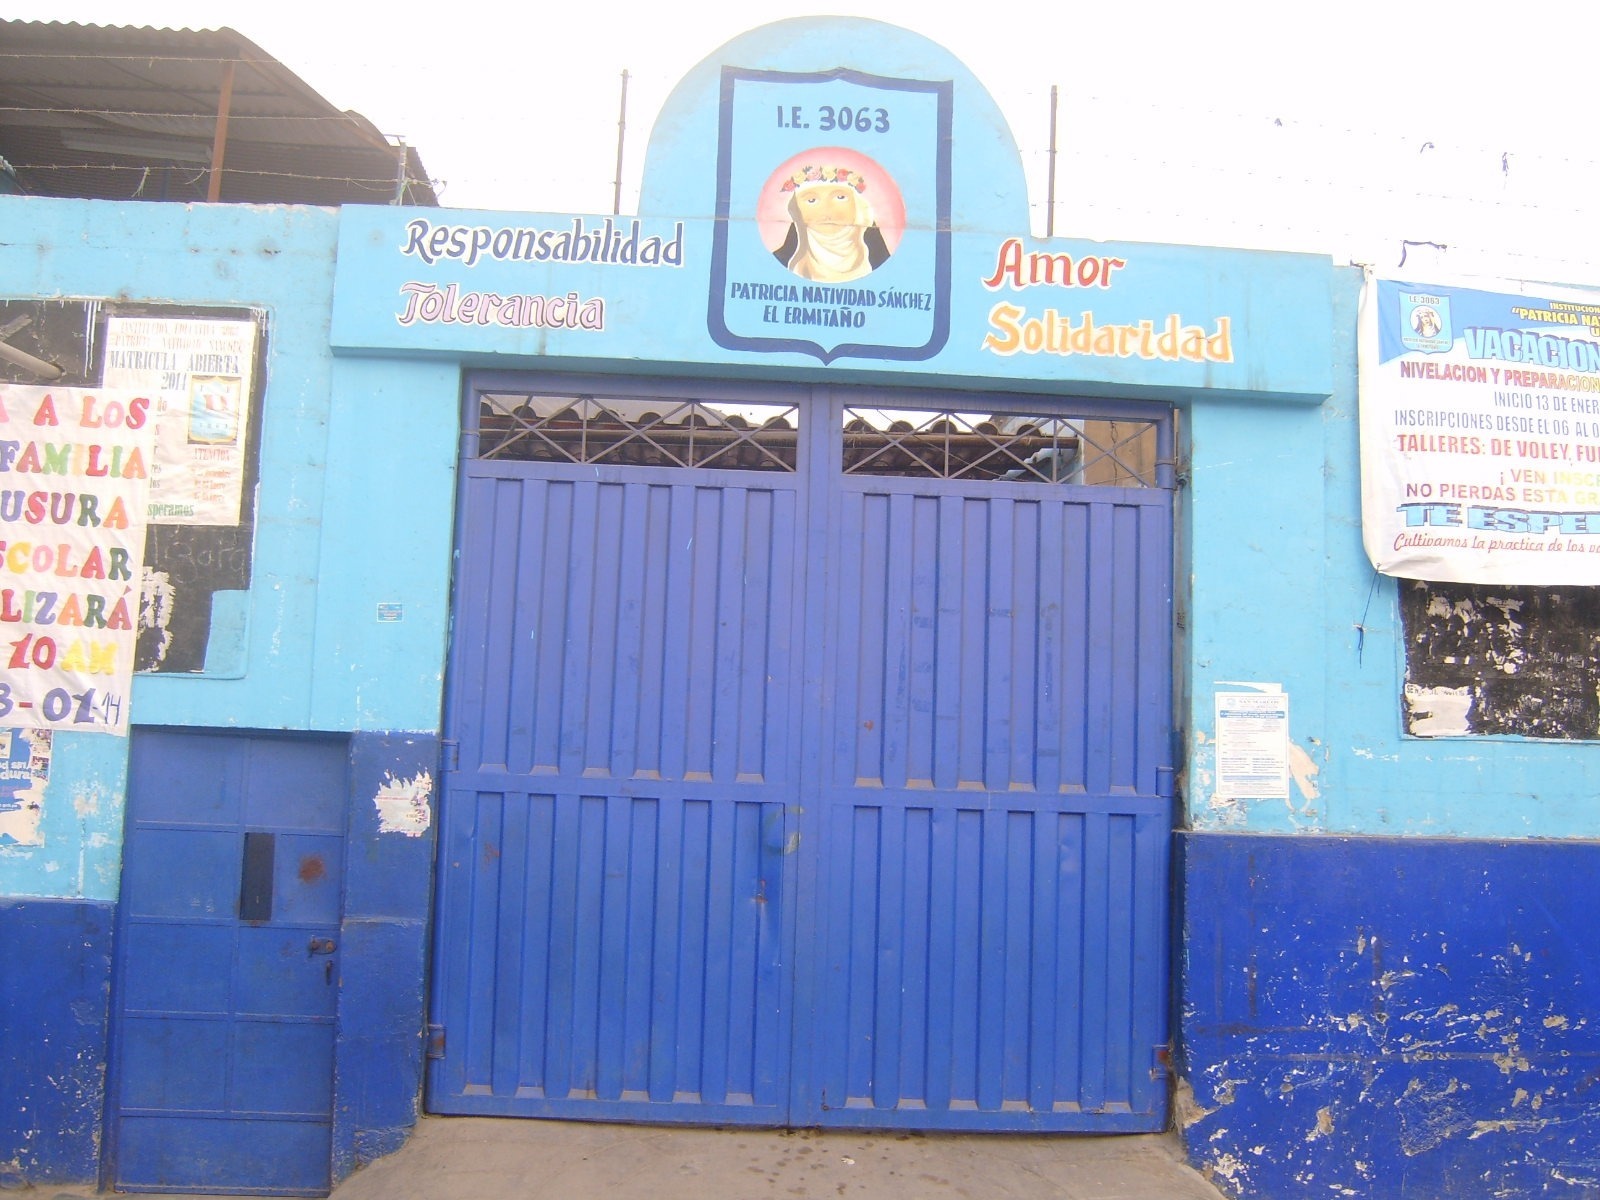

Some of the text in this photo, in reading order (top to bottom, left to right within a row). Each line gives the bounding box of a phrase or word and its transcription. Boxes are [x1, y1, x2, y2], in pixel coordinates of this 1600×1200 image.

[777, 105, 890, 133] I.E. 3063
[402, 218, 683, 266] Responsabilidad
[984, 238, 1126, 289] Amor
[398, 282, 604, 330] Tolerancia
[731, 282, 932, 312] PATRICIA NATIVIDAD SÁNCHEZ
[763, 305, 866, 328] EL ERMITAÑO
[985, 305, 1231, 363] Solidaridad
[110, 350, 239, 374] MATRICULA ABIERTA
[1401, 360, 1600, 393] NIVELACION Y PREPARACION
[33, 394, 59, 426] A
[80, 395, 150, 429] LOS
[1494, 391, 1532, 409] INICIO
[1536, 394, 1549, 411] 13
[1553, 396, 1568, 412] DE
[1395, 410, 1493, 430] INSCRIPCIONES
[1497, 416, 1534, 433] DESDE
[1538, 418, 1550, 434] EL
[1575, 422, 1589, 438] AL
[0, 440, 147, 479] FAMILIA
[1397, 434, 1487, 455] TALLERES:
[1491, 438, 1512, 457] DE
[1, 490, 129, 529] USURA
[1406, 483, 1432, 498] NO
[1440, 483, 1516, 501] PIERDAS
[1523, 488, 1568, 504] ESTA
[1396, 502, 1463, 527] TE
[1393, 532, 1467, 552] Cultivamos
[1472, 535, 1485, 550] la
[1488, 537, 1544, 554] practica
[1548, 537, 1563, 552] de
[1566, 538, 1585, 553] los
[0, 540, 132, 581] COLAR
[1, 585, 132, 630] LIZARÁ
[8, 633, 118, 675] 10 AM
